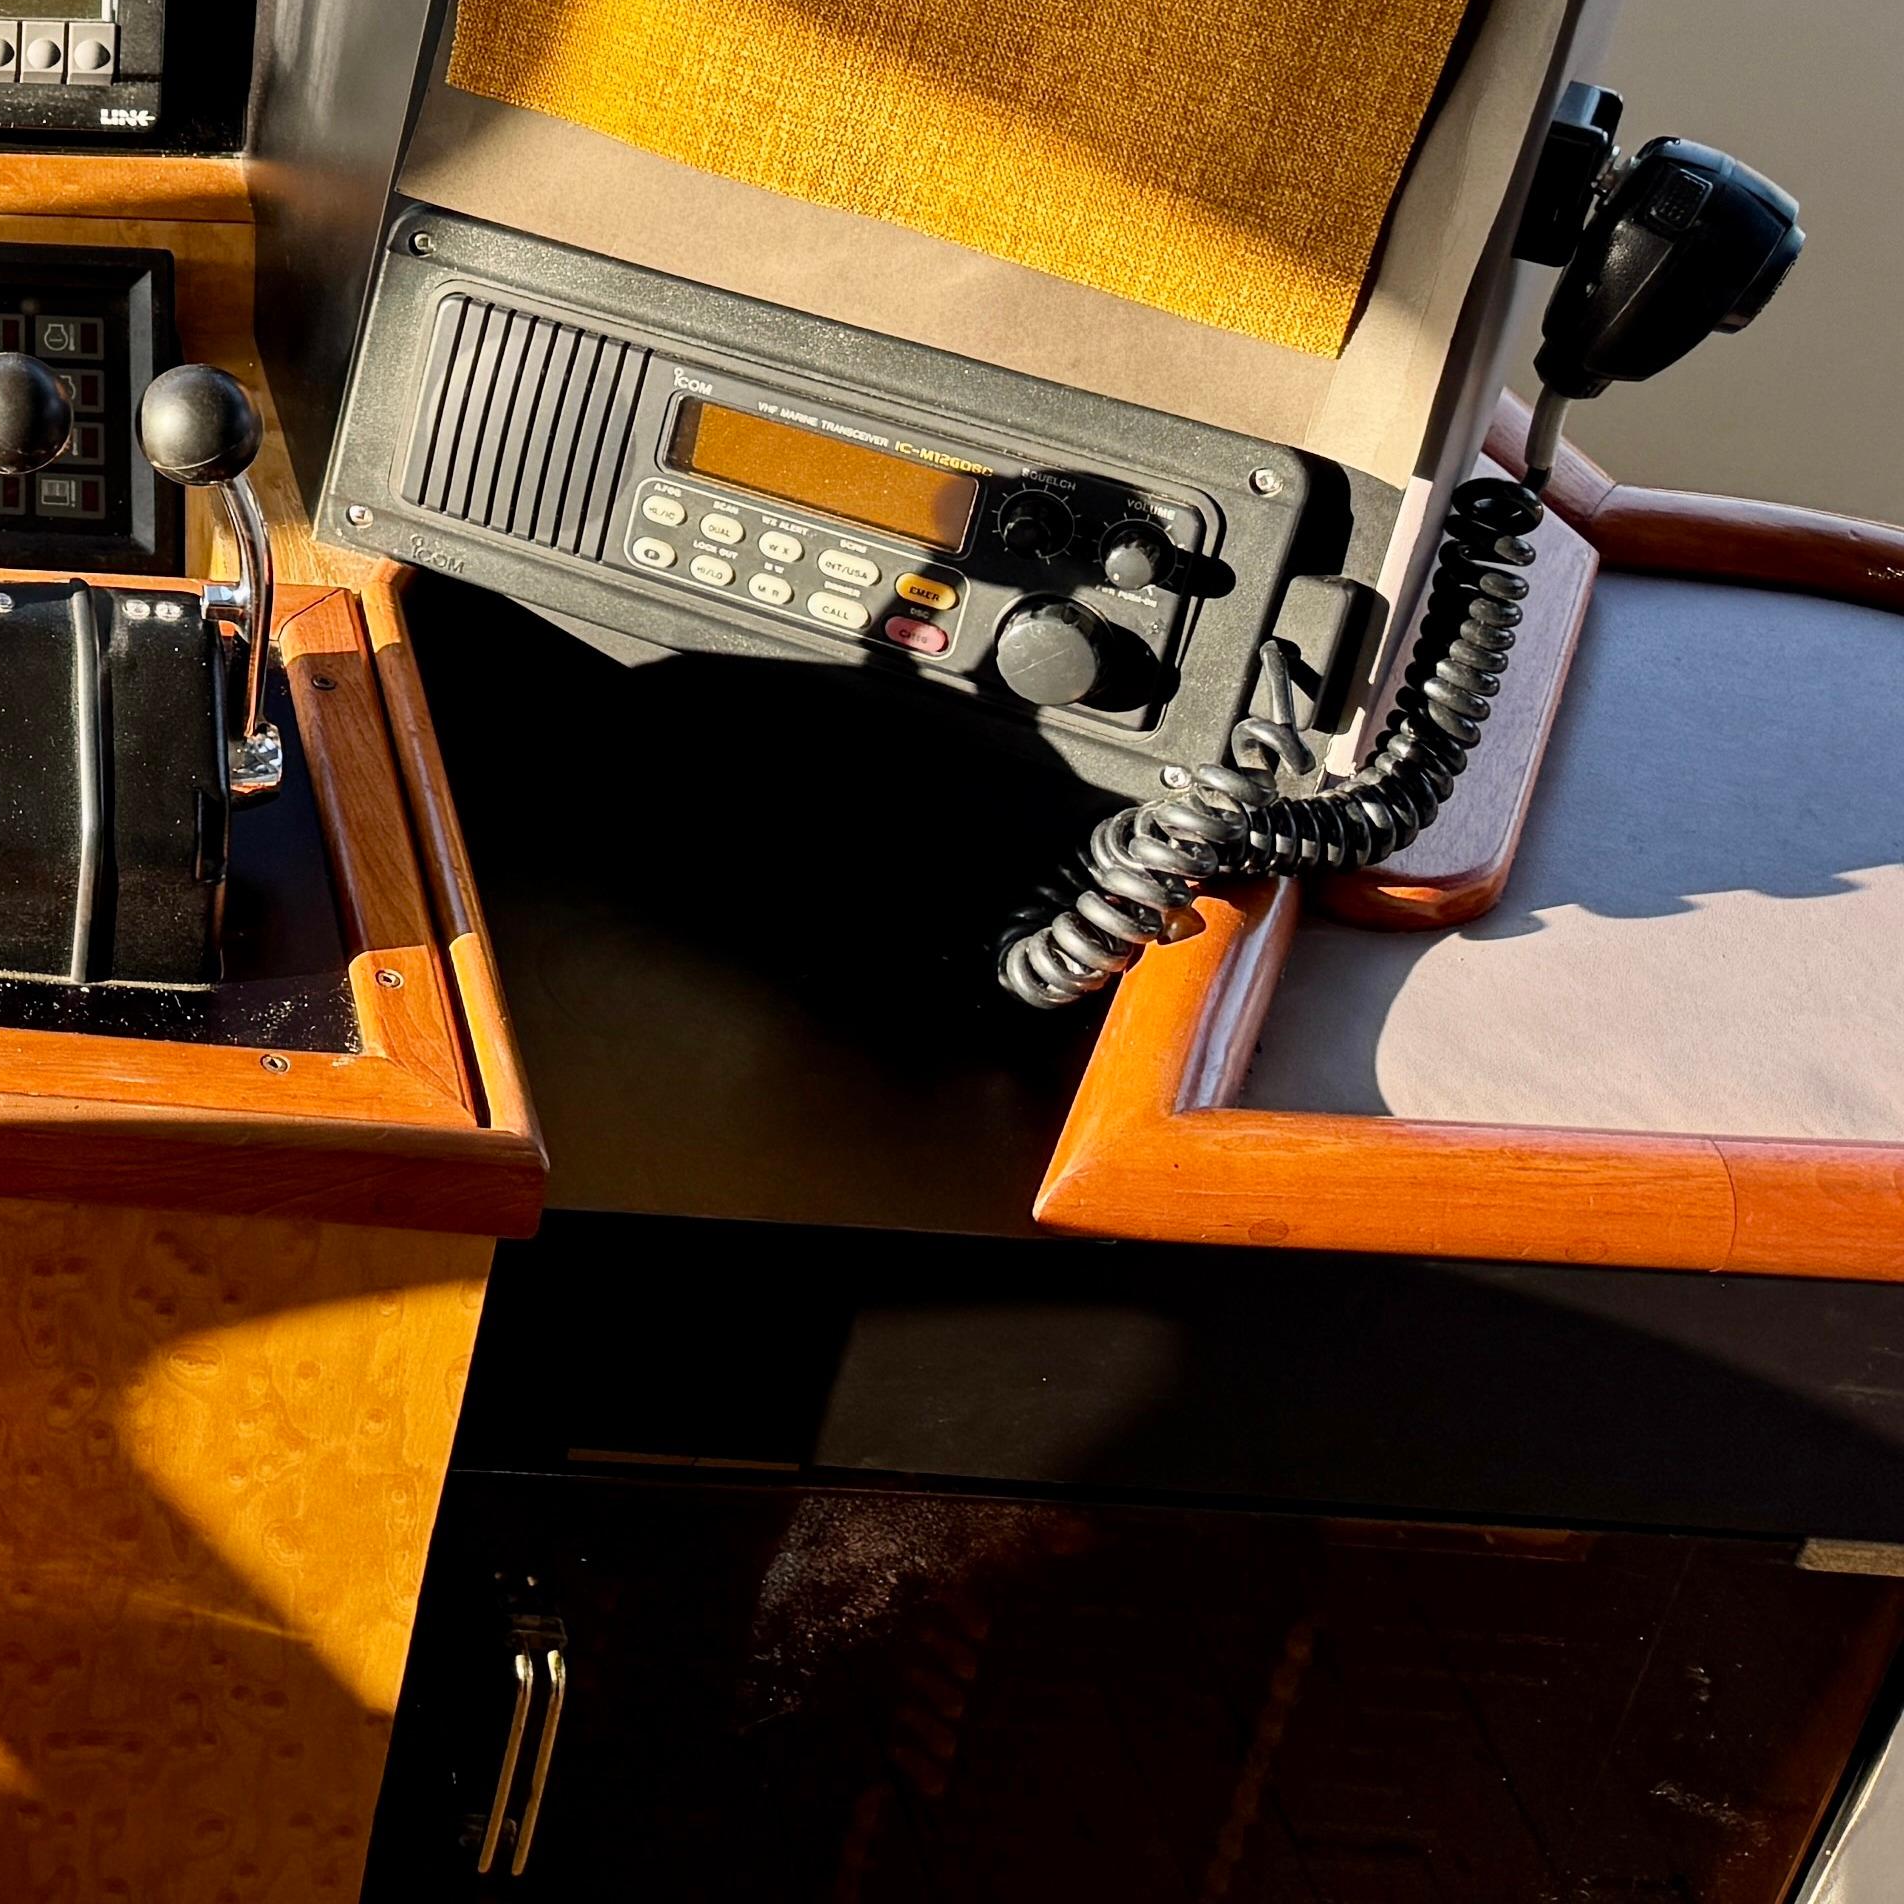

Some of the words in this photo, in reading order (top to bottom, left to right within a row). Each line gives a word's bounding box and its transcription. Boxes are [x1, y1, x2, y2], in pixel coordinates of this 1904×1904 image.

[99, 108, 156, 127] LINK
[757, 400, 776, 415] VHF
[780, 406, 819, 427] MARINE
[821, 418, 889, 448] TRANSCEIVER
[1021, 467, 1077, 491] SQUELCH
[712, 501, 740, 515] SCAN
[1127, 498, 1177, 521] VOLUME
[708, 524, 731, 538] DUAL
[779, 520, 810, 536] ALERT
[693, 539, 718, 554] LOCK
[719, 548, 739, 560] OUT
[825, 561, 868, 580] INT/USA
[909, 586, 941, 602] EMER
[821, 604, 849, 620] CALL
[909, 607, 930, 620] DSC
